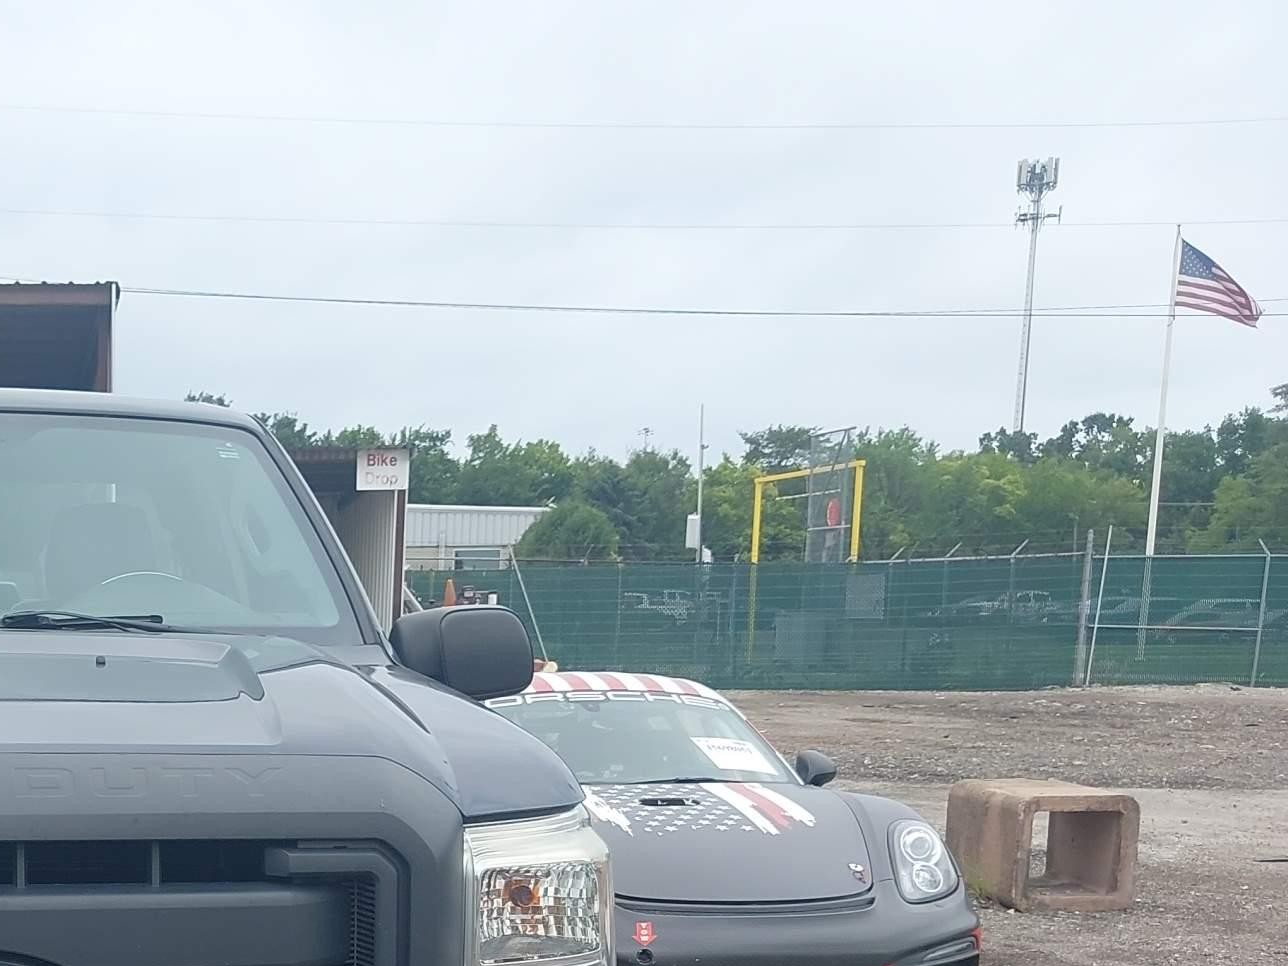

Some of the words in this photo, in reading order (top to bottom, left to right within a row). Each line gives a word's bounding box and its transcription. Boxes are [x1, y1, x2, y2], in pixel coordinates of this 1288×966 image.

[367, 454, 398, 466] Bike
[365, 471, 399, 486] Drop
[484, 690, 721, 710] ORSCHE
[12, 766, 288, 798] DUTY
